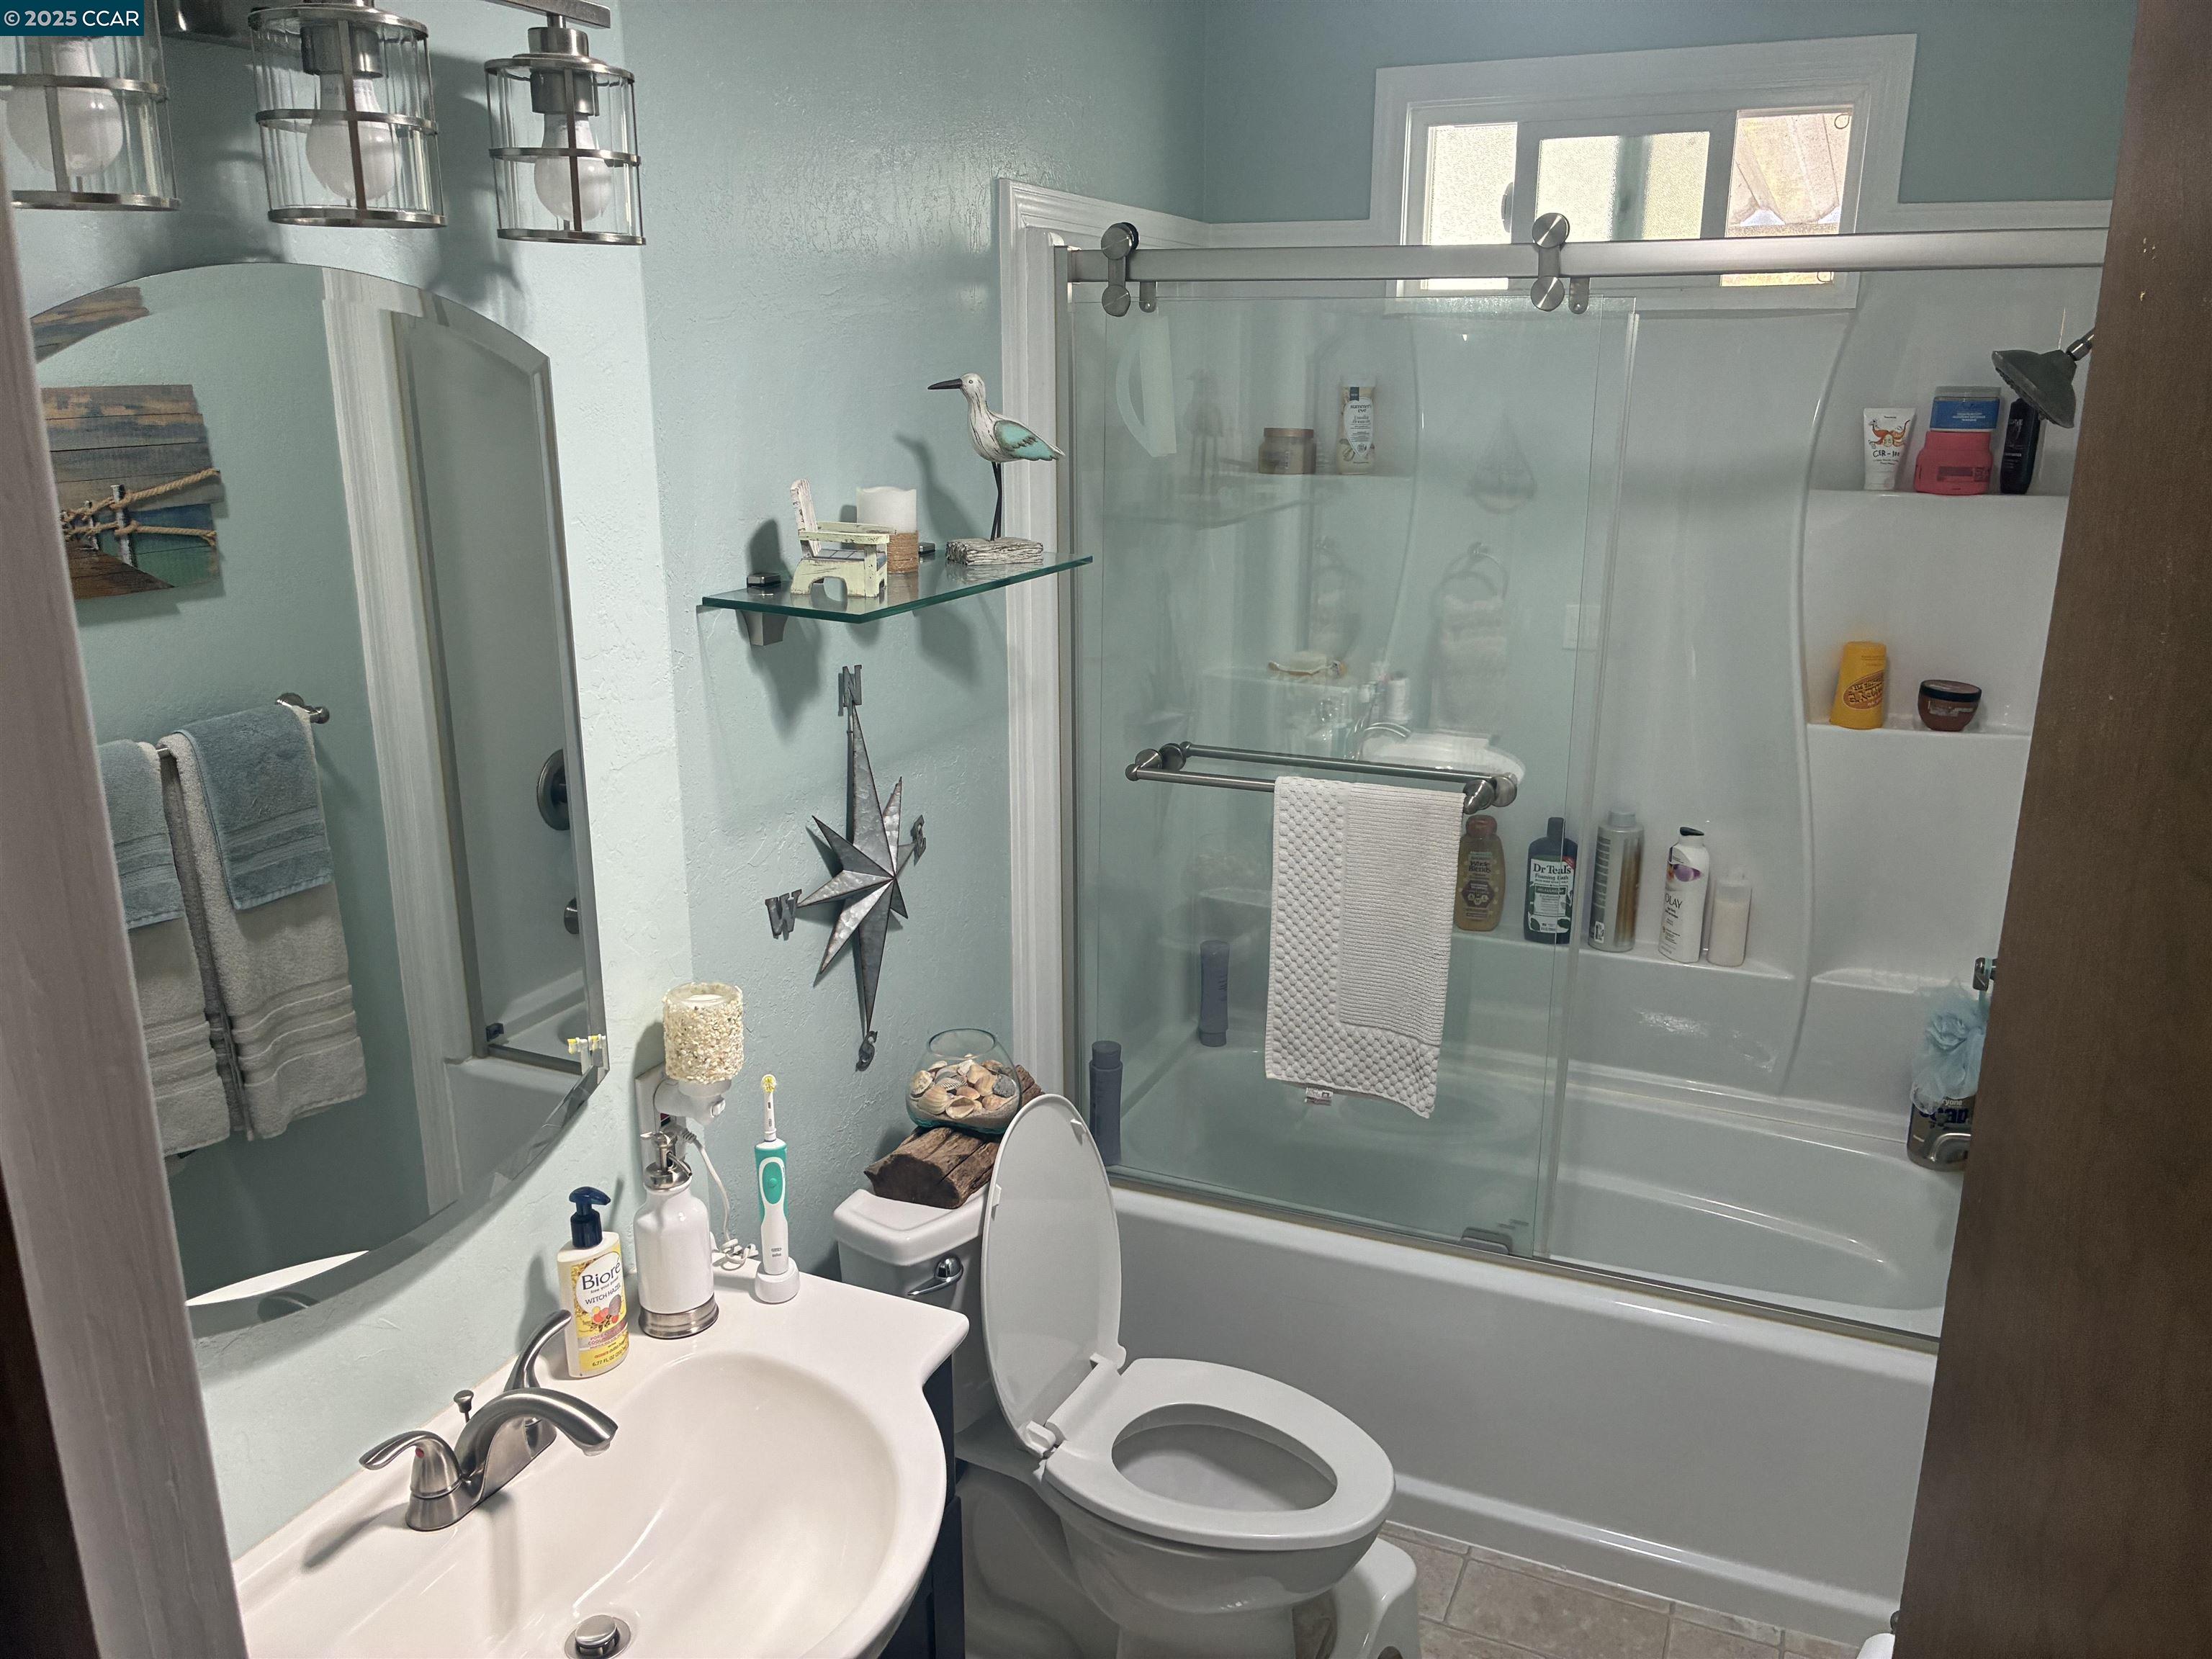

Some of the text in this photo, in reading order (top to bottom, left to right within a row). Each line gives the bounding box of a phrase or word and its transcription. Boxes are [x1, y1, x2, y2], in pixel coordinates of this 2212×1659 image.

[842, 664, 863, 706] N
[1533, 863, 1546, 873] Dr
[765, 888, 803, 936] W
[1665, 893, 1682, 909] OLAY
[582, 1256, 621, 1290] Bioré
[585, 1283, 621, 1305] WITCH HAZEL
